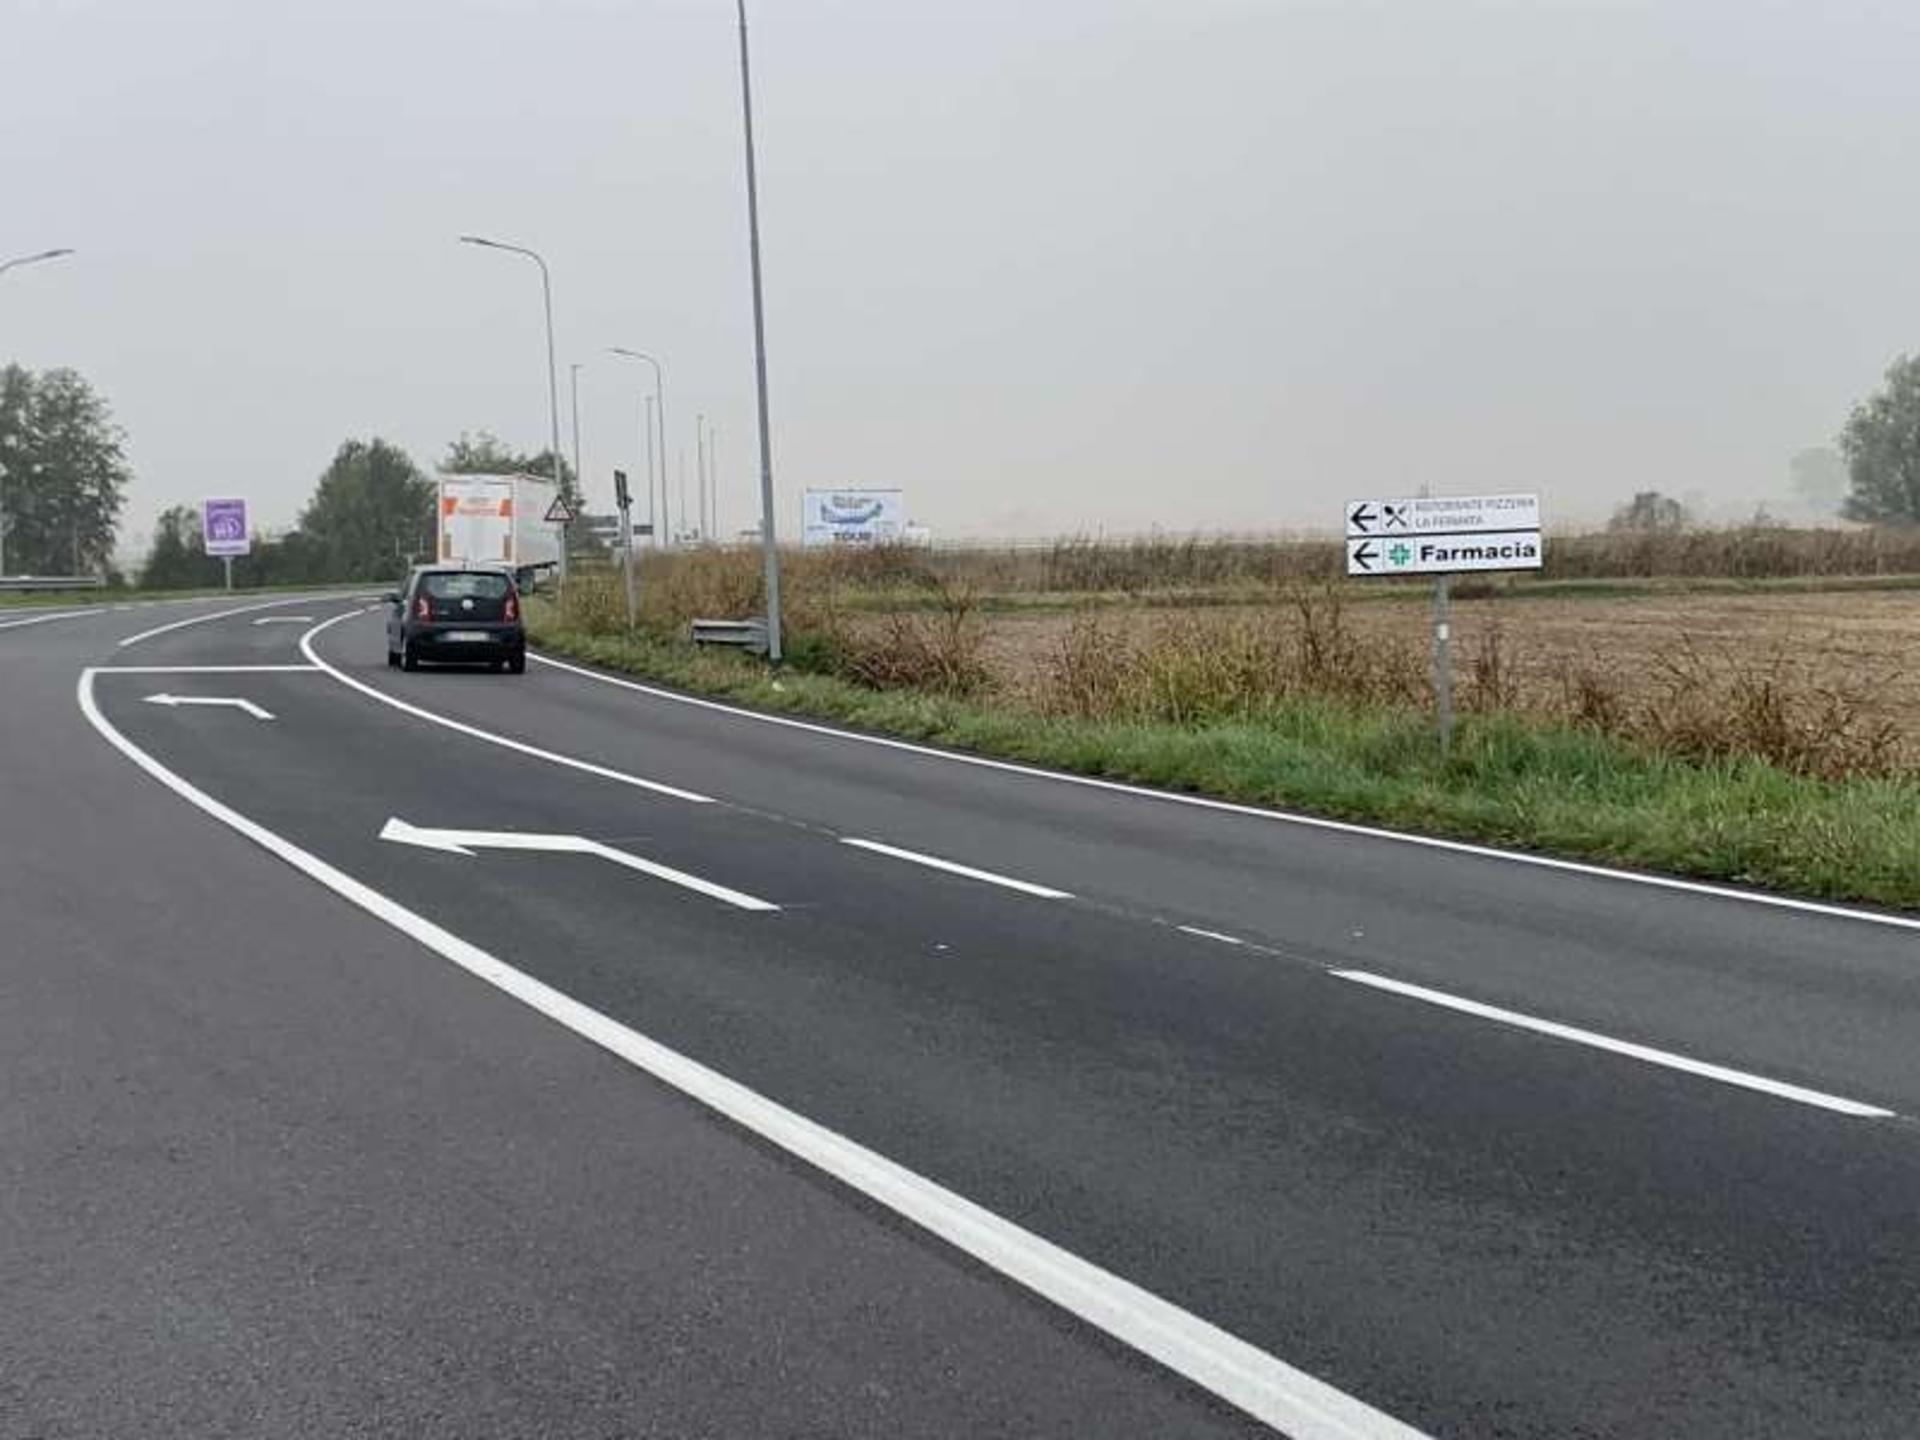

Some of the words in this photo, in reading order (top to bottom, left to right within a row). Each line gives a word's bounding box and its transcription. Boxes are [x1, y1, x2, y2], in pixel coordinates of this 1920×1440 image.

[1415, 499, 1482, 512] RISTORANTE
[1485, 497, 1535, 510] PIZZERIA
[1415, 517, 1431, 529] LA
[1419, 542, 1537, 562] Farmacia
